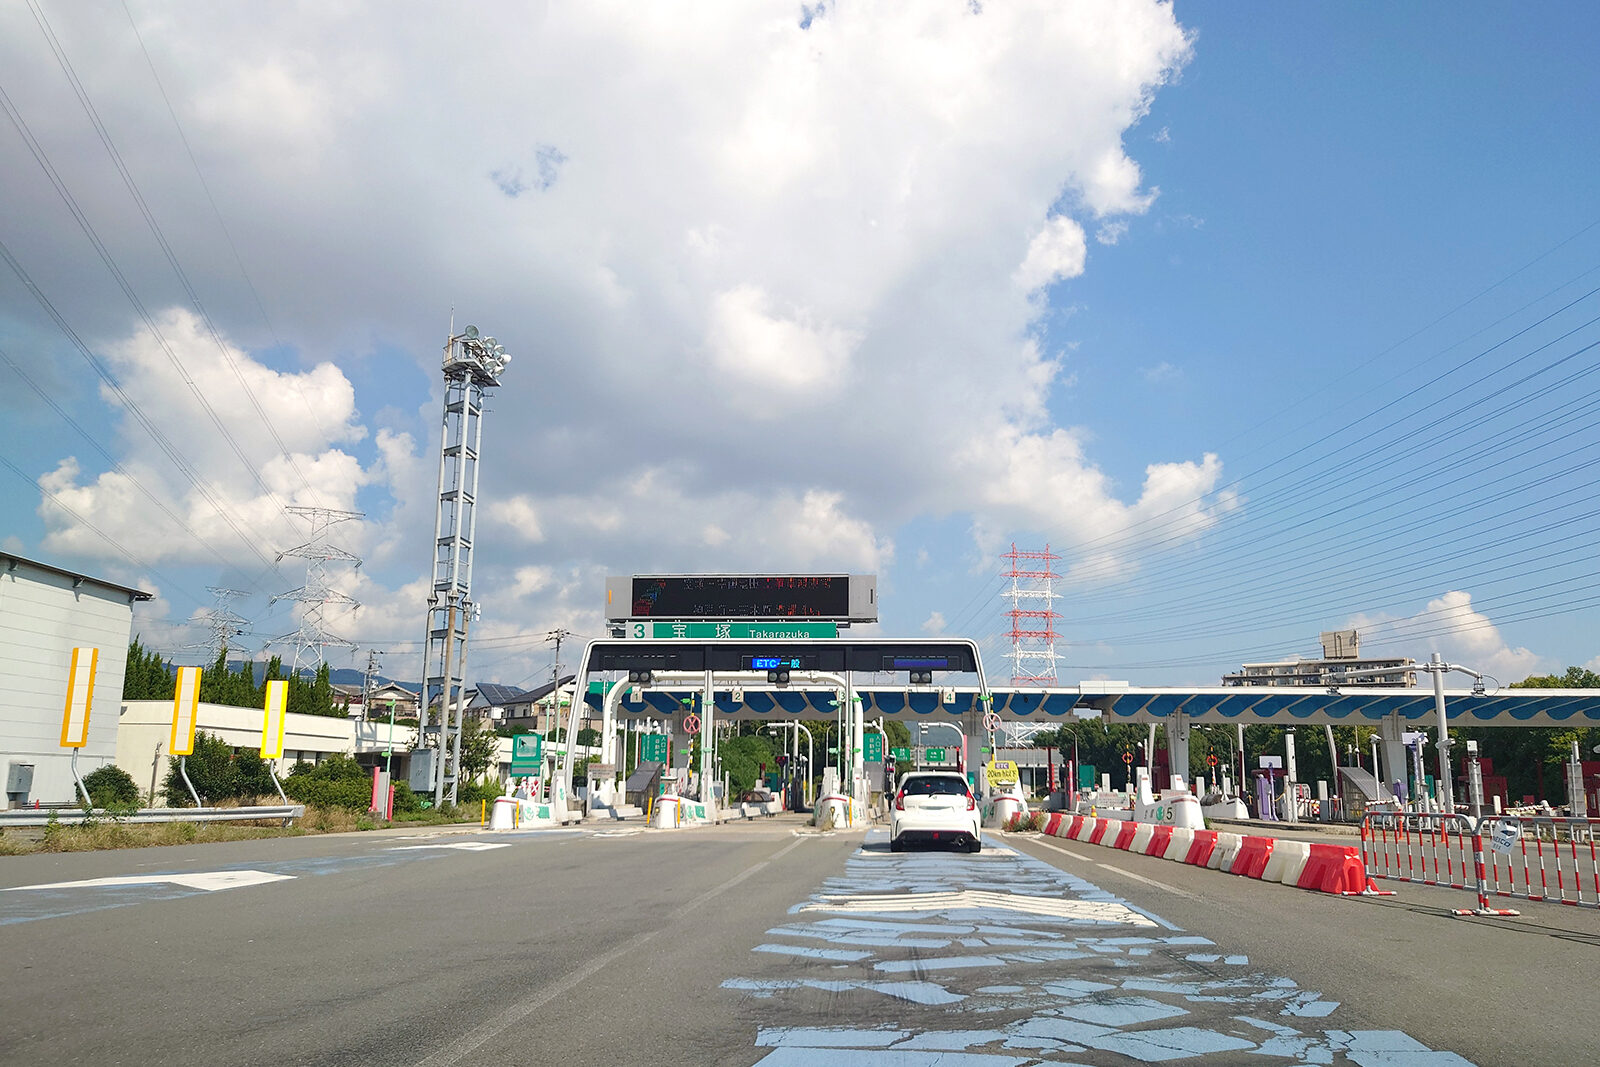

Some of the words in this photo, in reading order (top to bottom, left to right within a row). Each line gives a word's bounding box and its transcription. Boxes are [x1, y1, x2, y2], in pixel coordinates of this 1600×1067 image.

[633, 623, 646, 639] 3
[672, 623, 731, 639] 宝塚
[749, 629, 810, 639] Takarazuka
[735, 691, 741, 700] 2
[840, 691, 846, 700] 3
[946, 693, 952, 702] 4
[1166, 807, 1173, 820] 5
